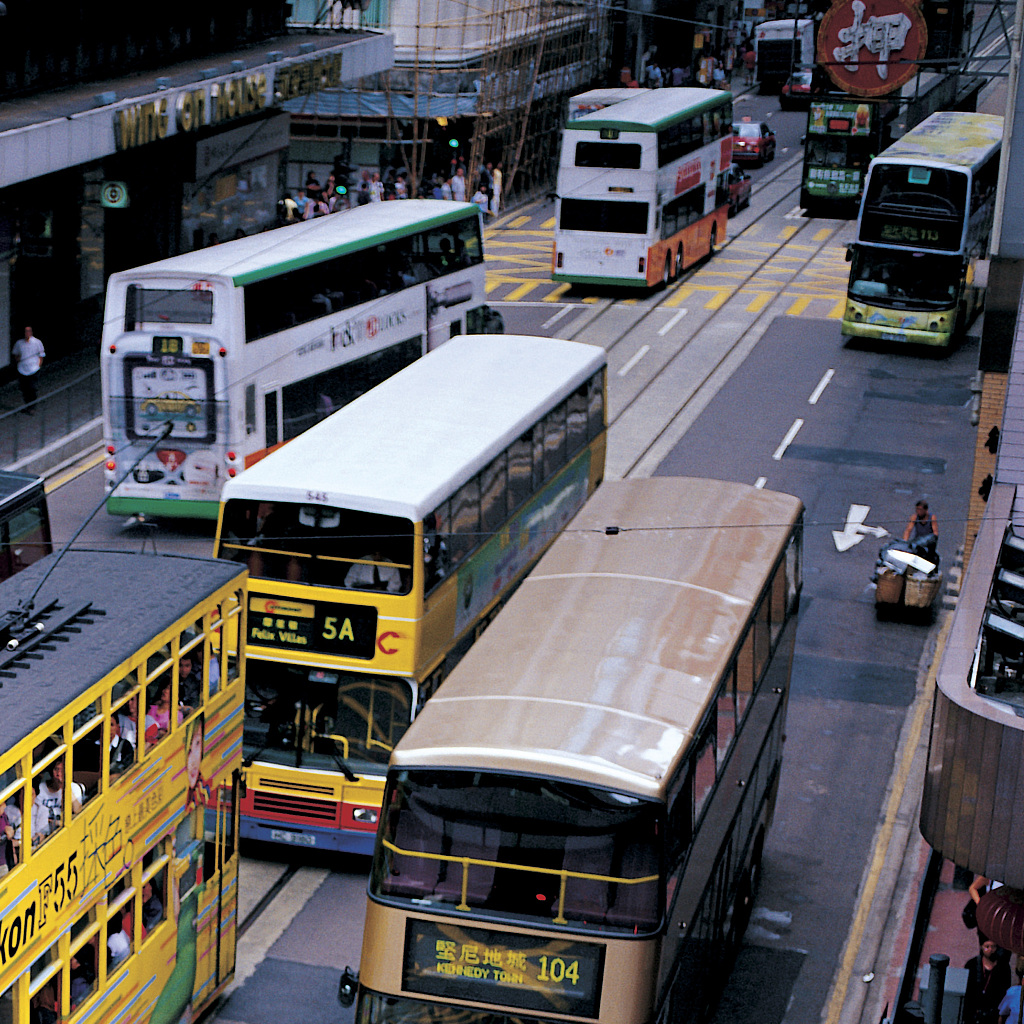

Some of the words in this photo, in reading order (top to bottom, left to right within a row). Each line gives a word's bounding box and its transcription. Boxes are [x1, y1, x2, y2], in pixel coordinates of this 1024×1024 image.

[833, 0, 912, 80] 押
[278, 631, 307, 645] Villas
[322, 616, 354, 641] 5A
[38, 851, 78, 929] F55
[436, 962, 490, 979] KENNEDY
[493, 970, 524, 984] TOWN
[537, 955, 580, 985] 104
